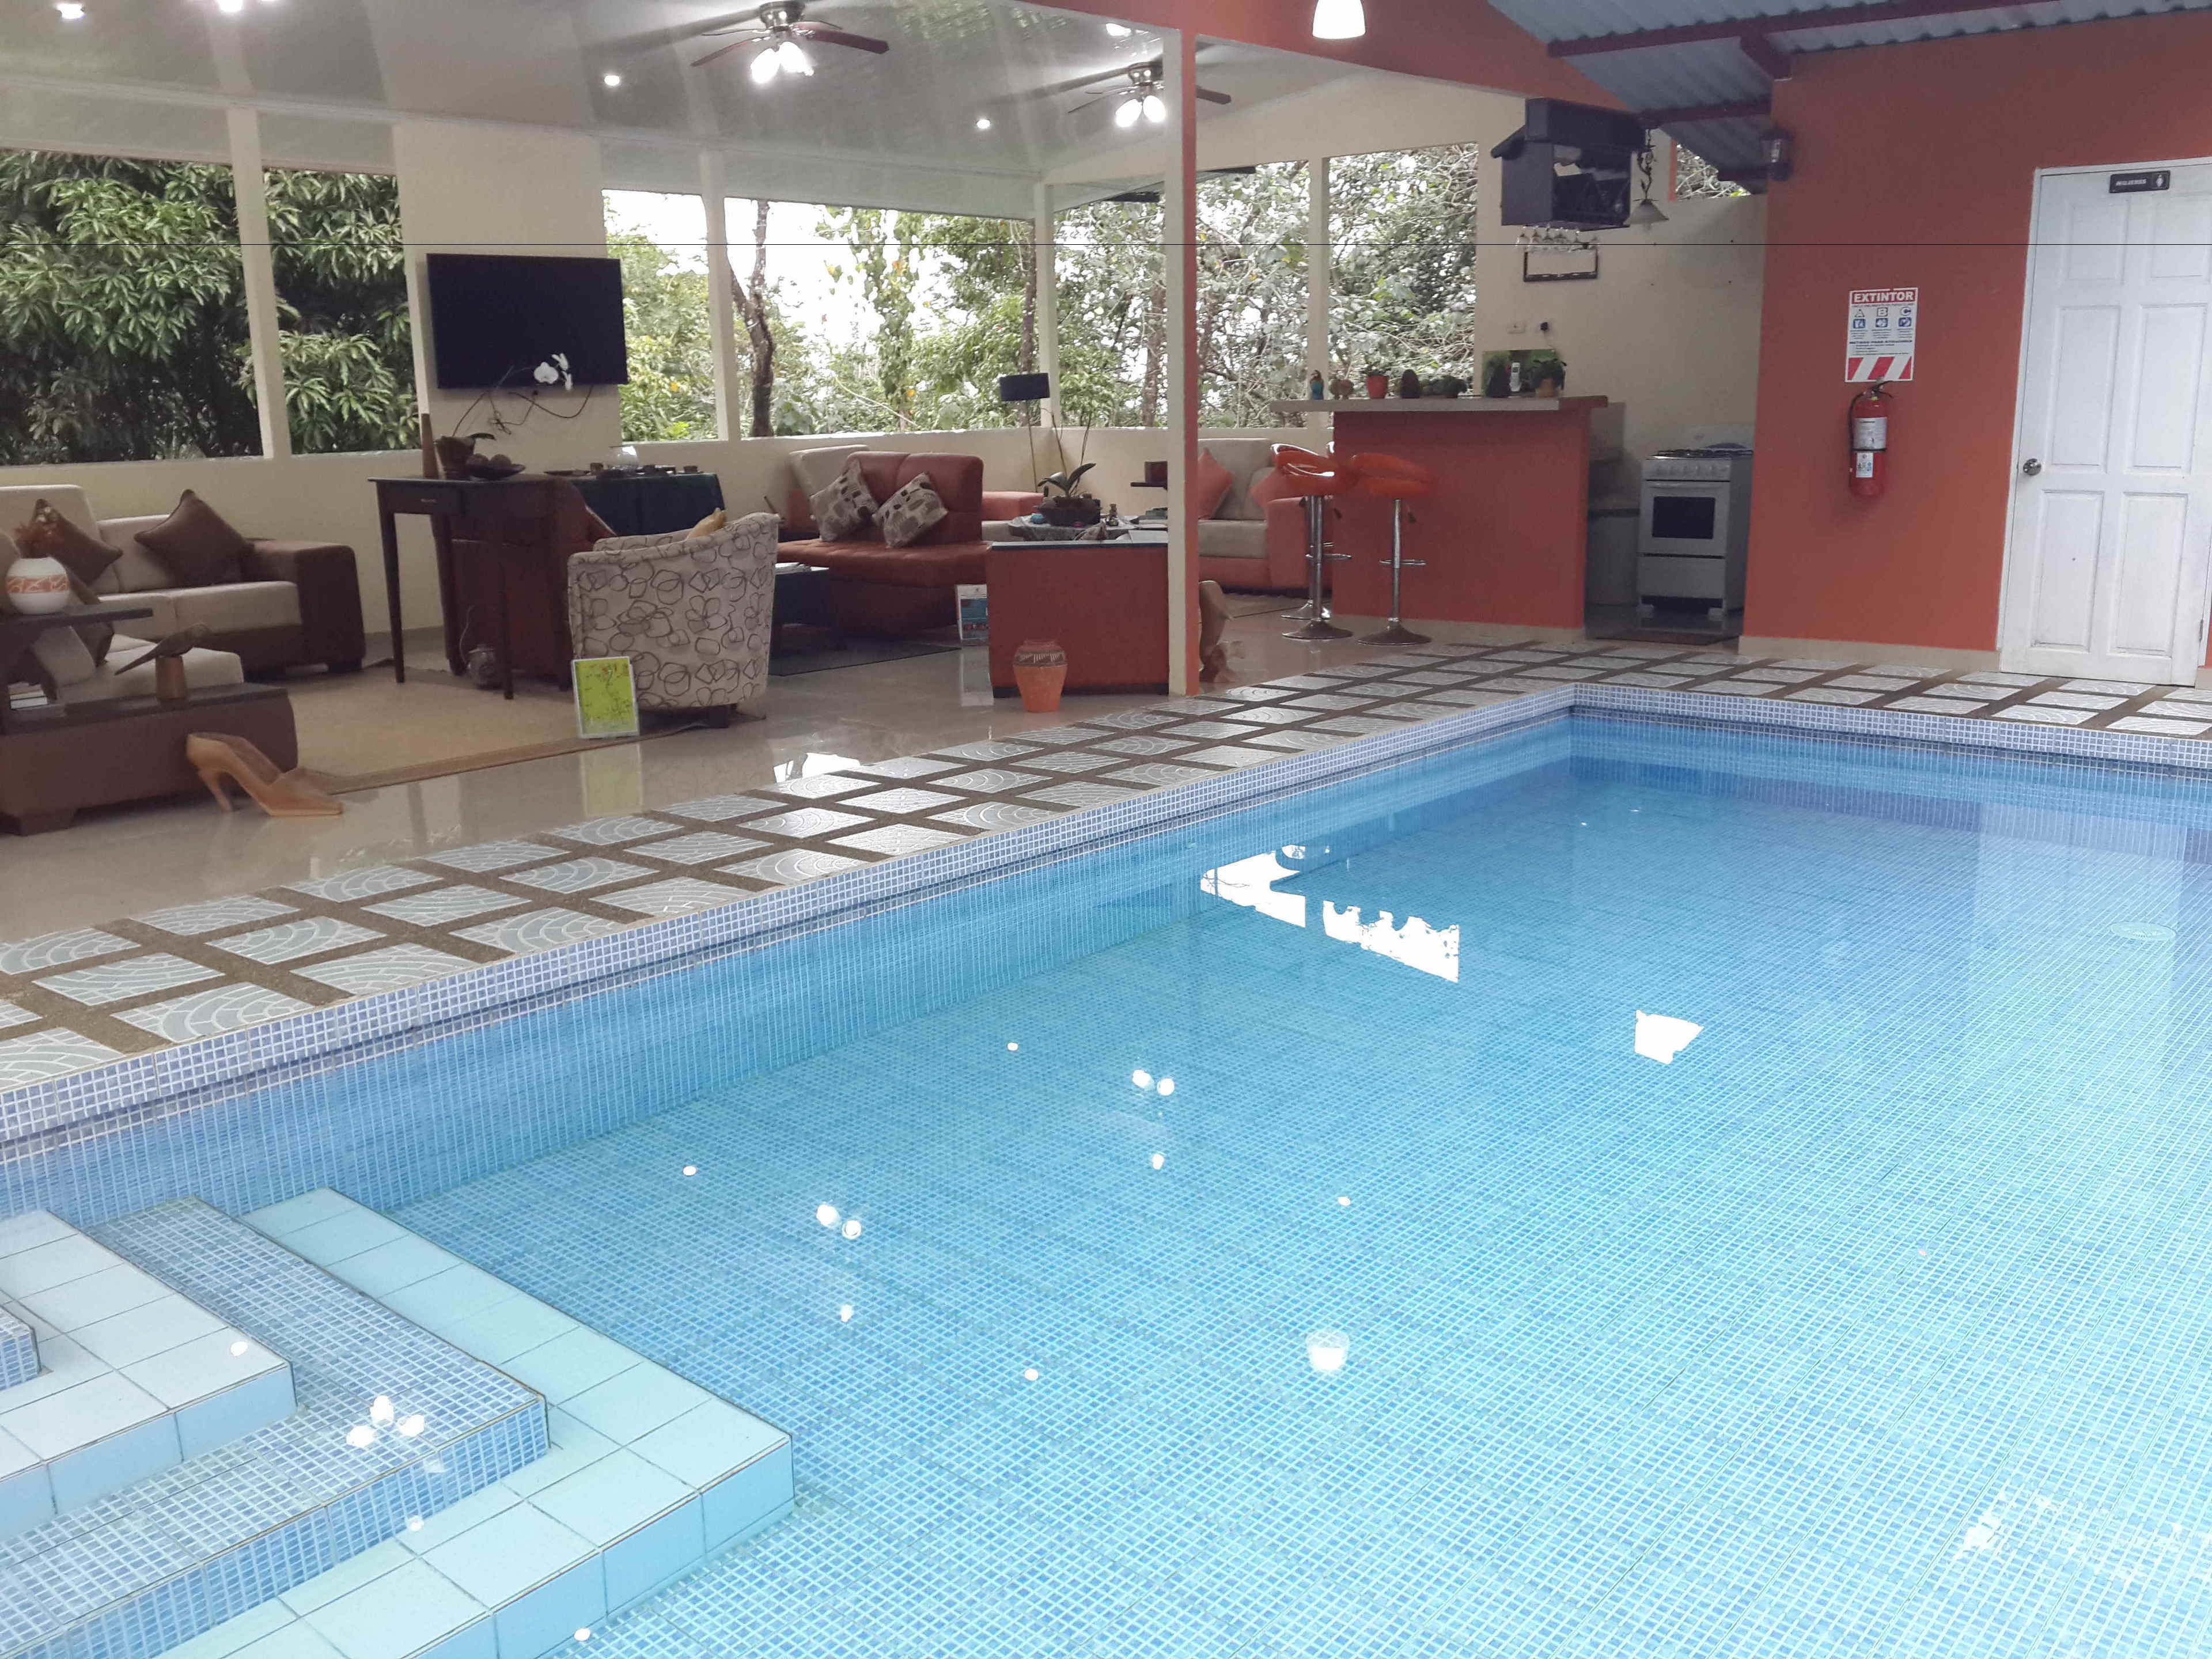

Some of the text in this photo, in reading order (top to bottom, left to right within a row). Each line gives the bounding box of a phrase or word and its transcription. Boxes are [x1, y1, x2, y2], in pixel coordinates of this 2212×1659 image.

[1854, 291, 1914, 302] EXTINTOR
[1854, 306, 1912, 318] A B C
